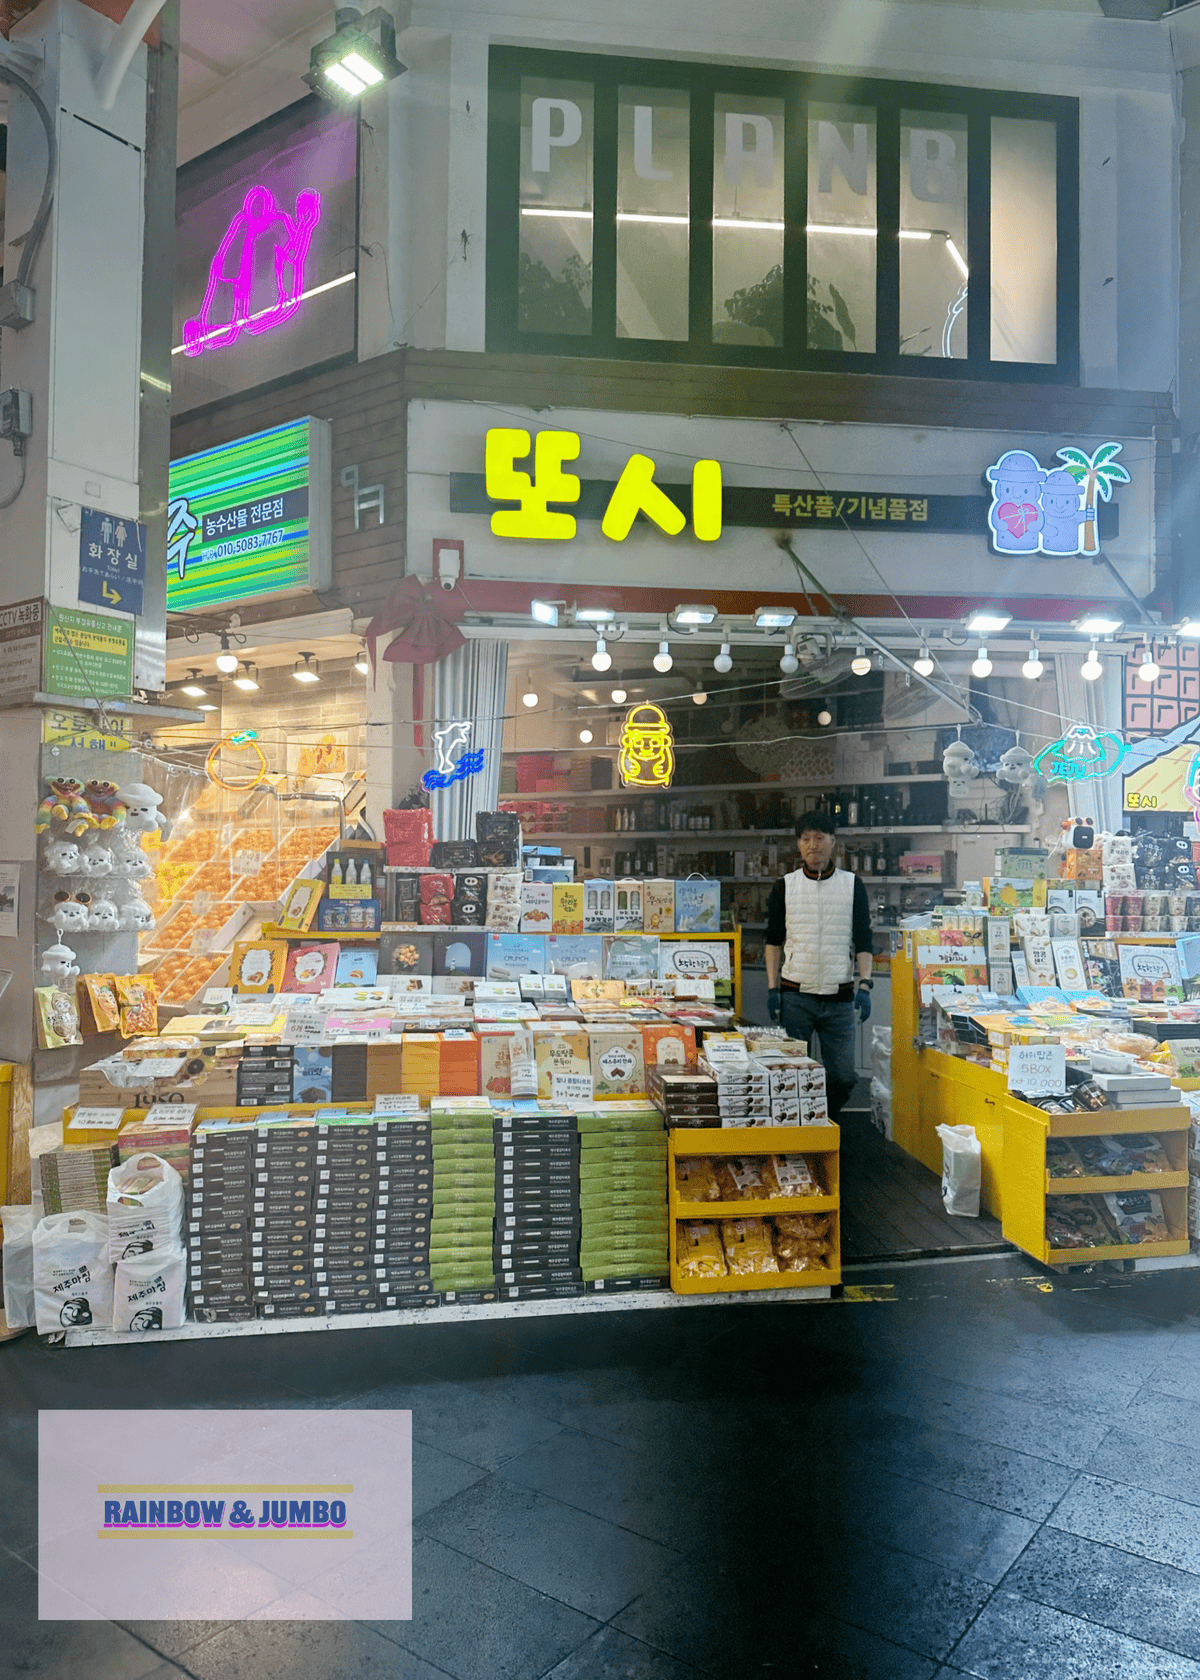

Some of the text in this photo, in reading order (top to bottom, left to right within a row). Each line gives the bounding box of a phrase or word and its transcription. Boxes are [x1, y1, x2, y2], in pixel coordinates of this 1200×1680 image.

[485, 428, 723, 542] 또시
[205, 497, 284, 536] 농수산물 전문점
[771, 494, 929, 522] 특산품/기념품점
[88, 542, 138, 571] 화장실
[18, 604, 40, 624] 녹화중
[1050, 761, 1086, 779] JEJU
[1127, 792, 1158, 809] 또시
[52, 1270, 91, 1293] 제주마씸
[127, 1280, 167, 1303] 제주마씸
